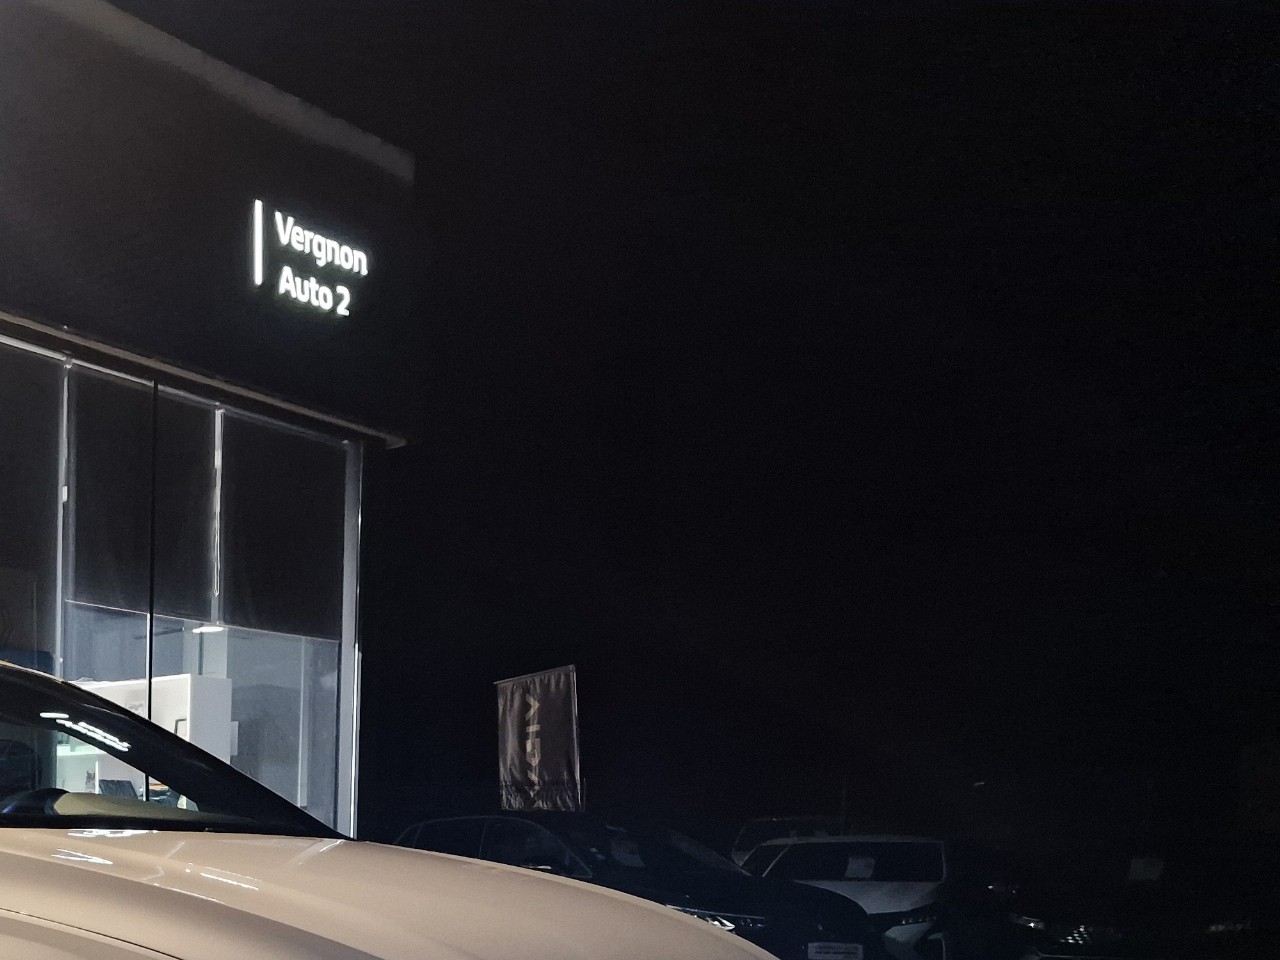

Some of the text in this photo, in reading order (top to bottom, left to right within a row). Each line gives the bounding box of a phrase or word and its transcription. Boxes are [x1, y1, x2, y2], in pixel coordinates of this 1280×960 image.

[274, 210, 369, 276] Vergnon
[278, 265, 351, 317] Auto 2
